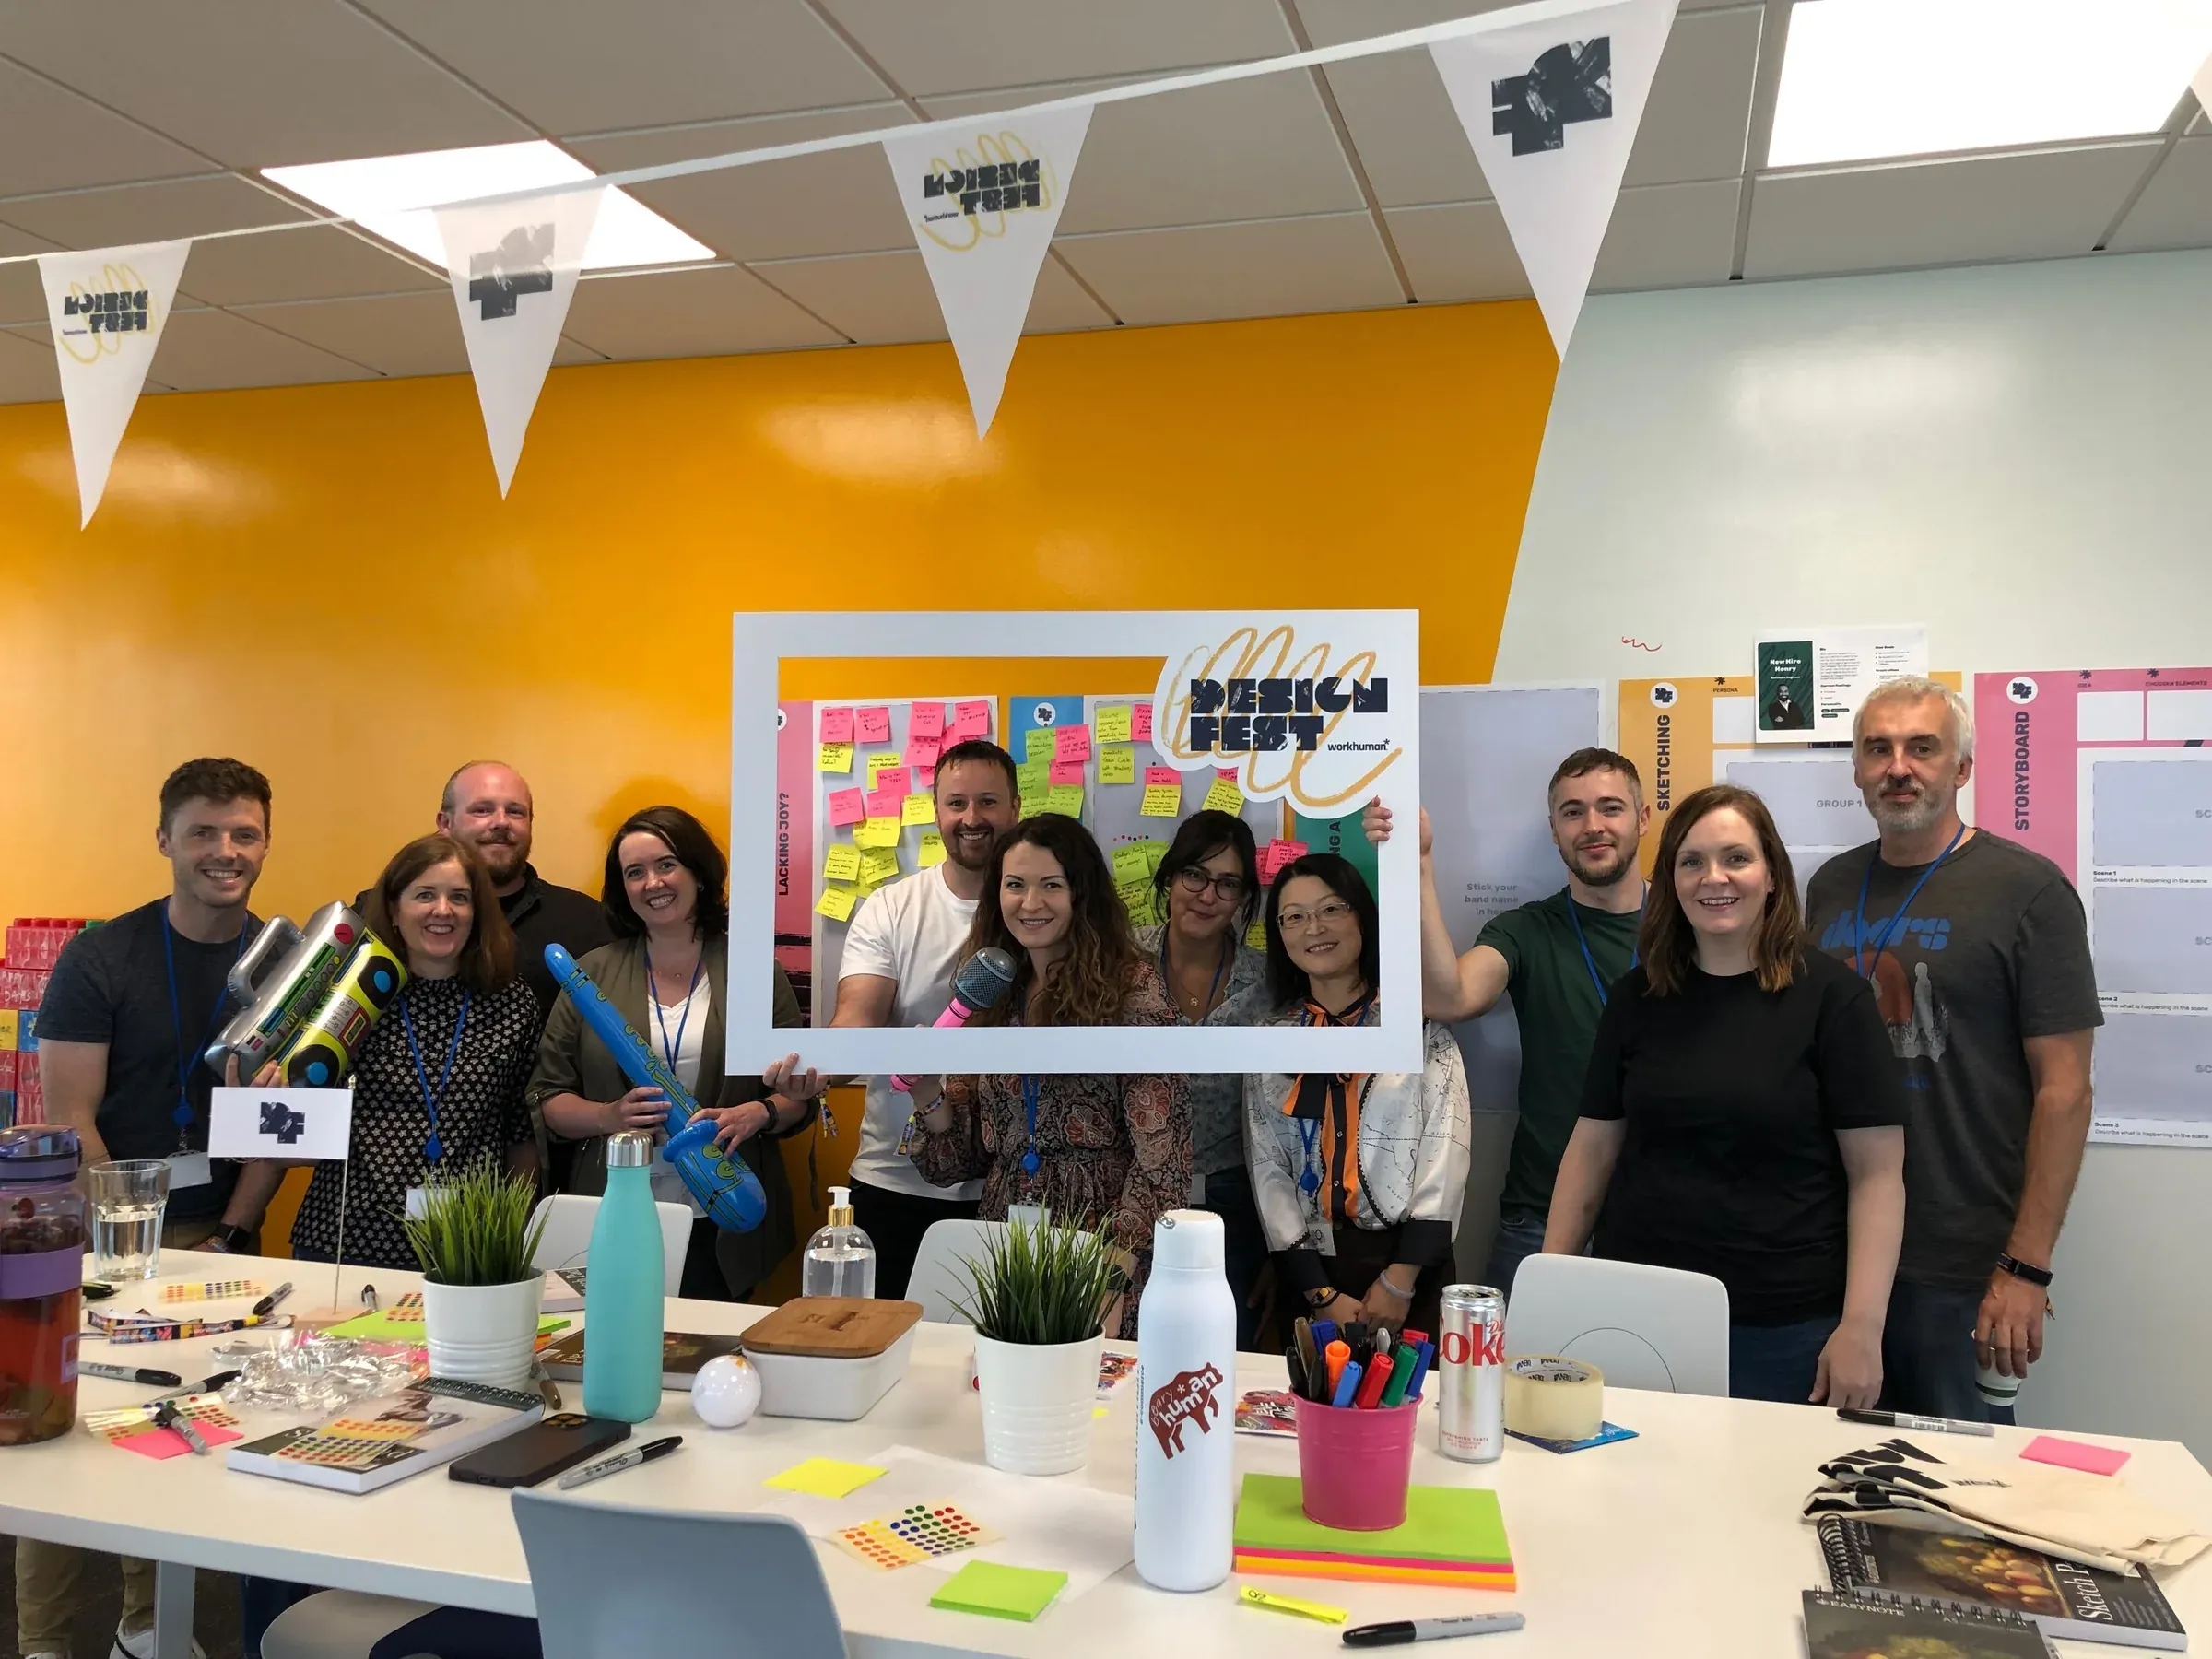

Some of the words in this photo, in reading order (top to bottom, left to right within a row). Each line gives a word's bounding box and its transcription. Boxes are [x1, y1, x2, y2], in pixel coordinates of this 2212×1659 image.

[1774, 665, 1797, 674] Henry
[1191, 677, 1389, 713] DESIGN
[1191, 716, 1324, 752] FEST
[1657, 715, 1671, 811] SKETCHING
[2015, 711, 2030, 831] STORYBOARD
[779, 792, 790, 830] JOY?
[1816, 799, 1855, 808] GROUP
[779, 833, 790, 896] LACKING
[1465, 895, 1489, 903] band
[1491, 896, 1519, 904] name
[1466, 882, 1492, 891] Stick
[1494, 884, 1519, 892] your
[1440, 1316, 1505, 1367] oke
[2055, 1560, 2090, 1576] P
[1830, 1600, 1906, 1618] EASYNOTE
[2064, 1579, 2114, 1622] Sketch
